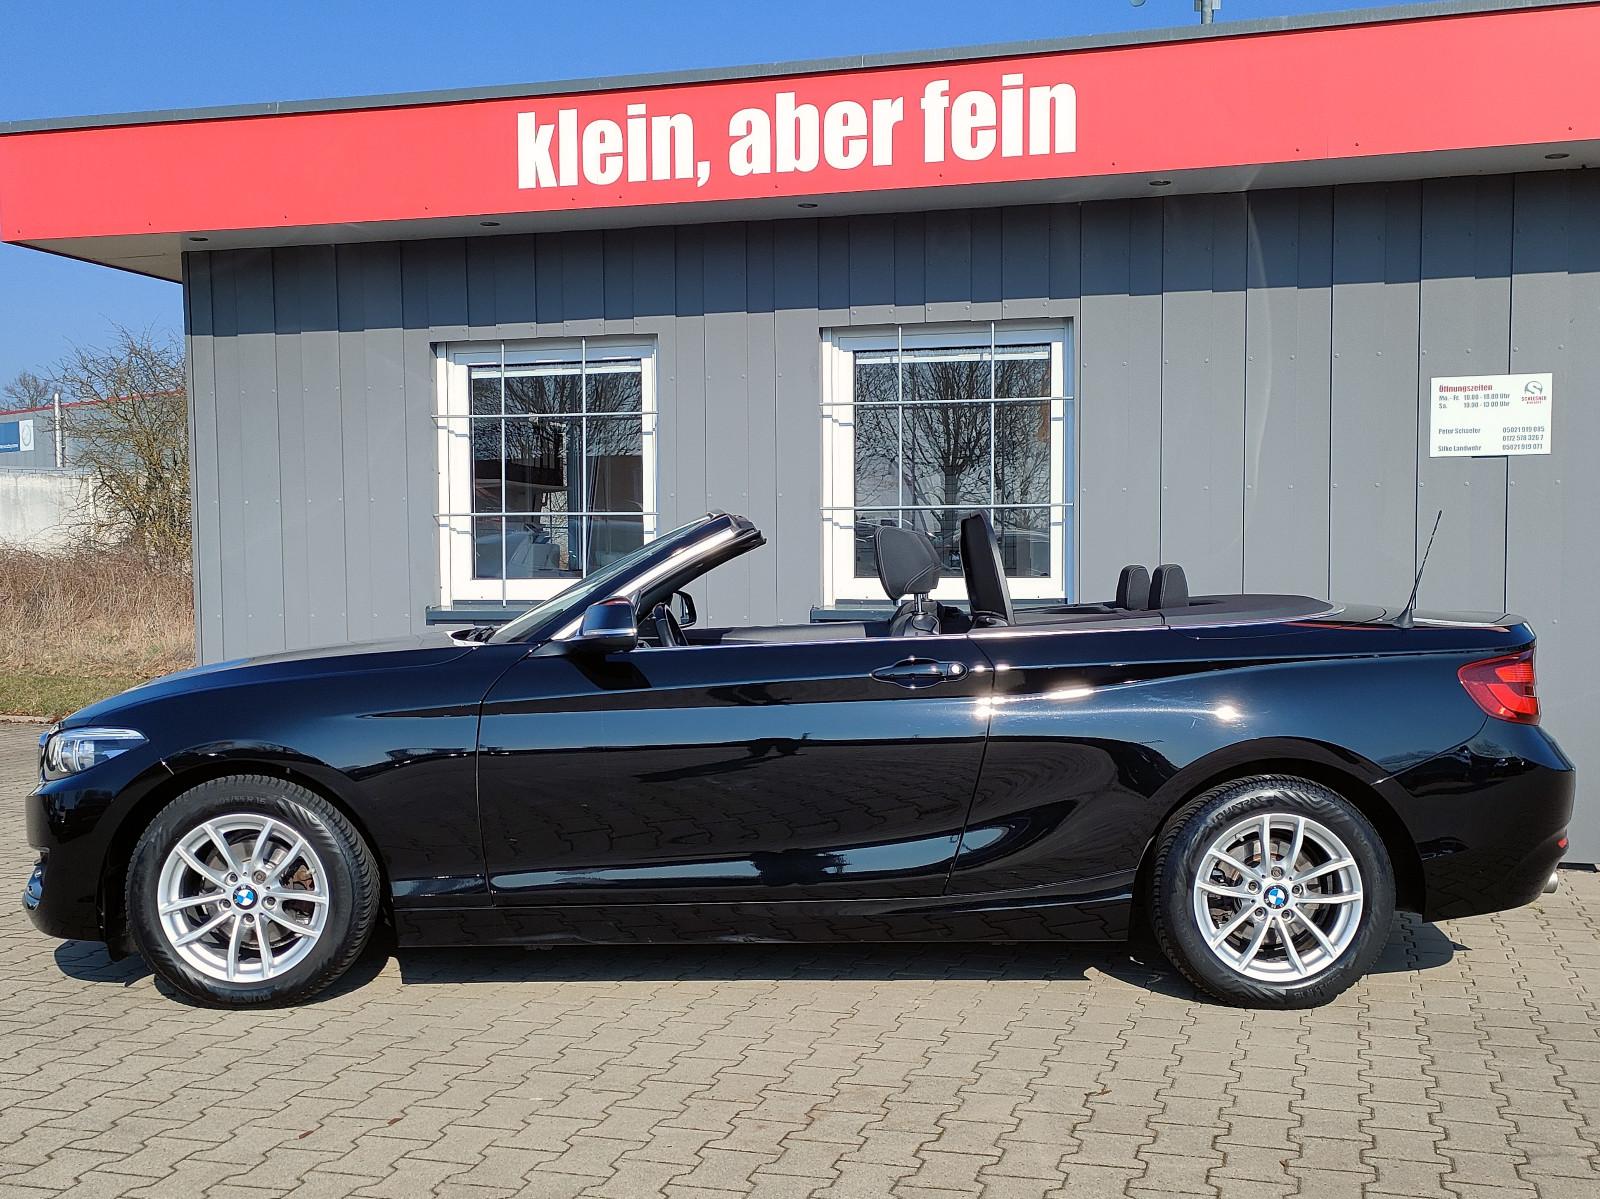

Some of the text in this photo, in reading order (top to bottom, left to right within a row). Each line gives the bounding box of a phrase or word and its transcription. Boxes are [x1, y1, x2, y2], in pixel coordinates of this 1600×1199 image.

[517, 73, 1077, 189] klein, aber fein
